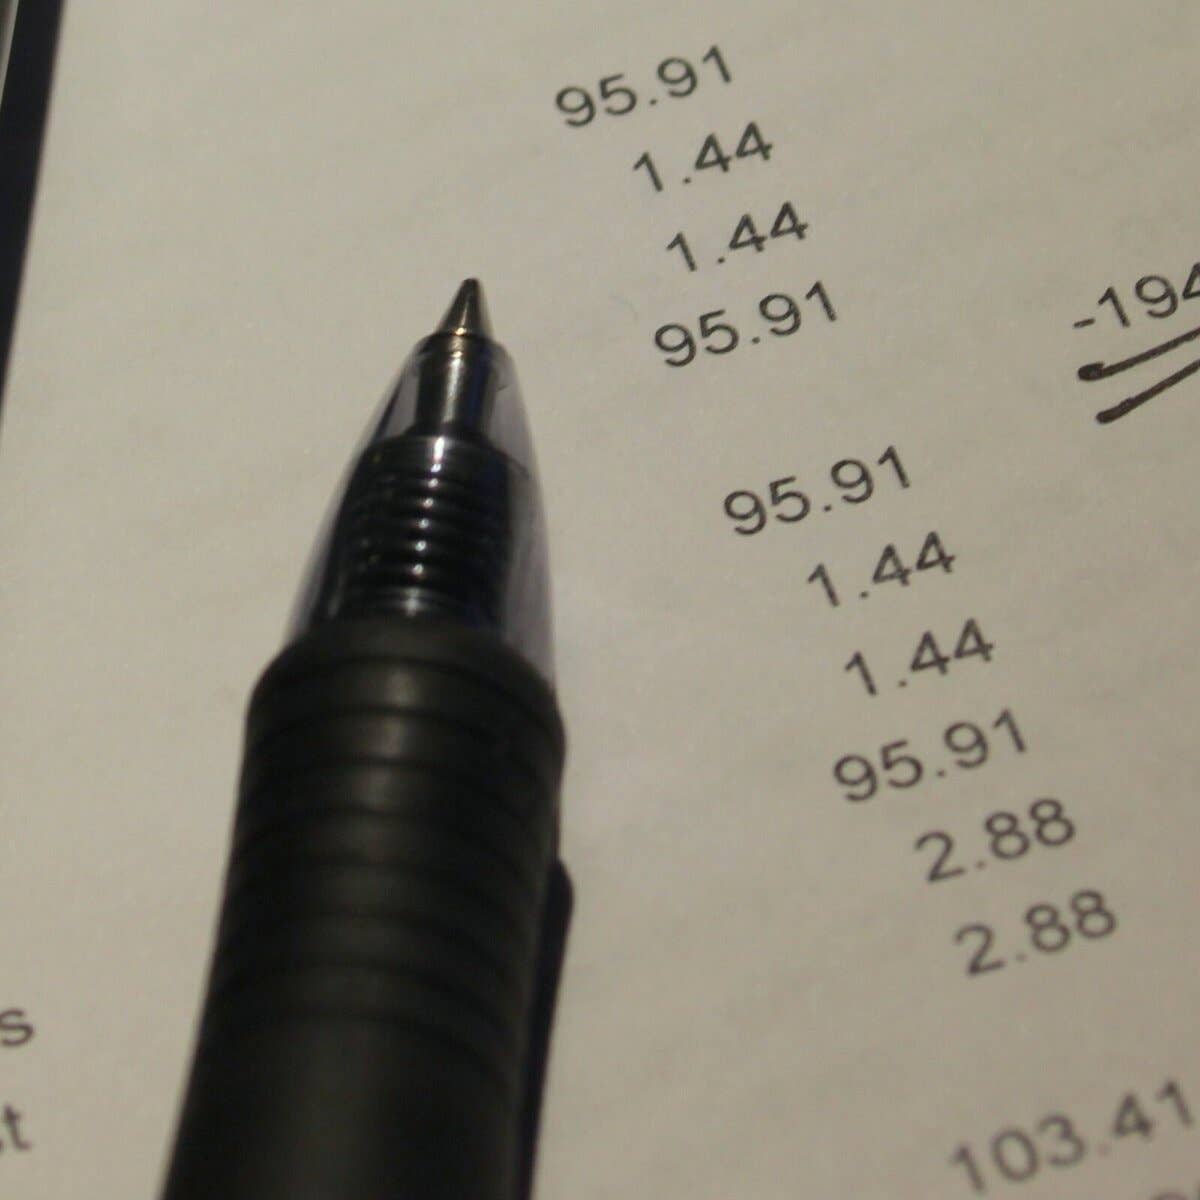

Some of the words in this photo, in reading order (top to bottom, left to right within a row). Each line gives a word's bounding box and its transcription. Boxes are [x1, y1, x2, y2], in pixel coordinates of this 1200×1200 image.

[554, 44, 734, 127] 95.91
[632, 121, 774, 193] 1.44
[665, 201, 809, 272] 1.44
[654, 280, 838, 368] 95.91
[723, 445, 912, 536] 95.91
[807, 530, 957, 608] 1.44
[843, 617, 995, 697] 1.44
[832, 707, 1028, 804] 95.91
[913, 797, 1076, 884] 2.88
[953, 888, 1117, 977] 2.88
[949, 1078, 1195, 1195] 103.41
